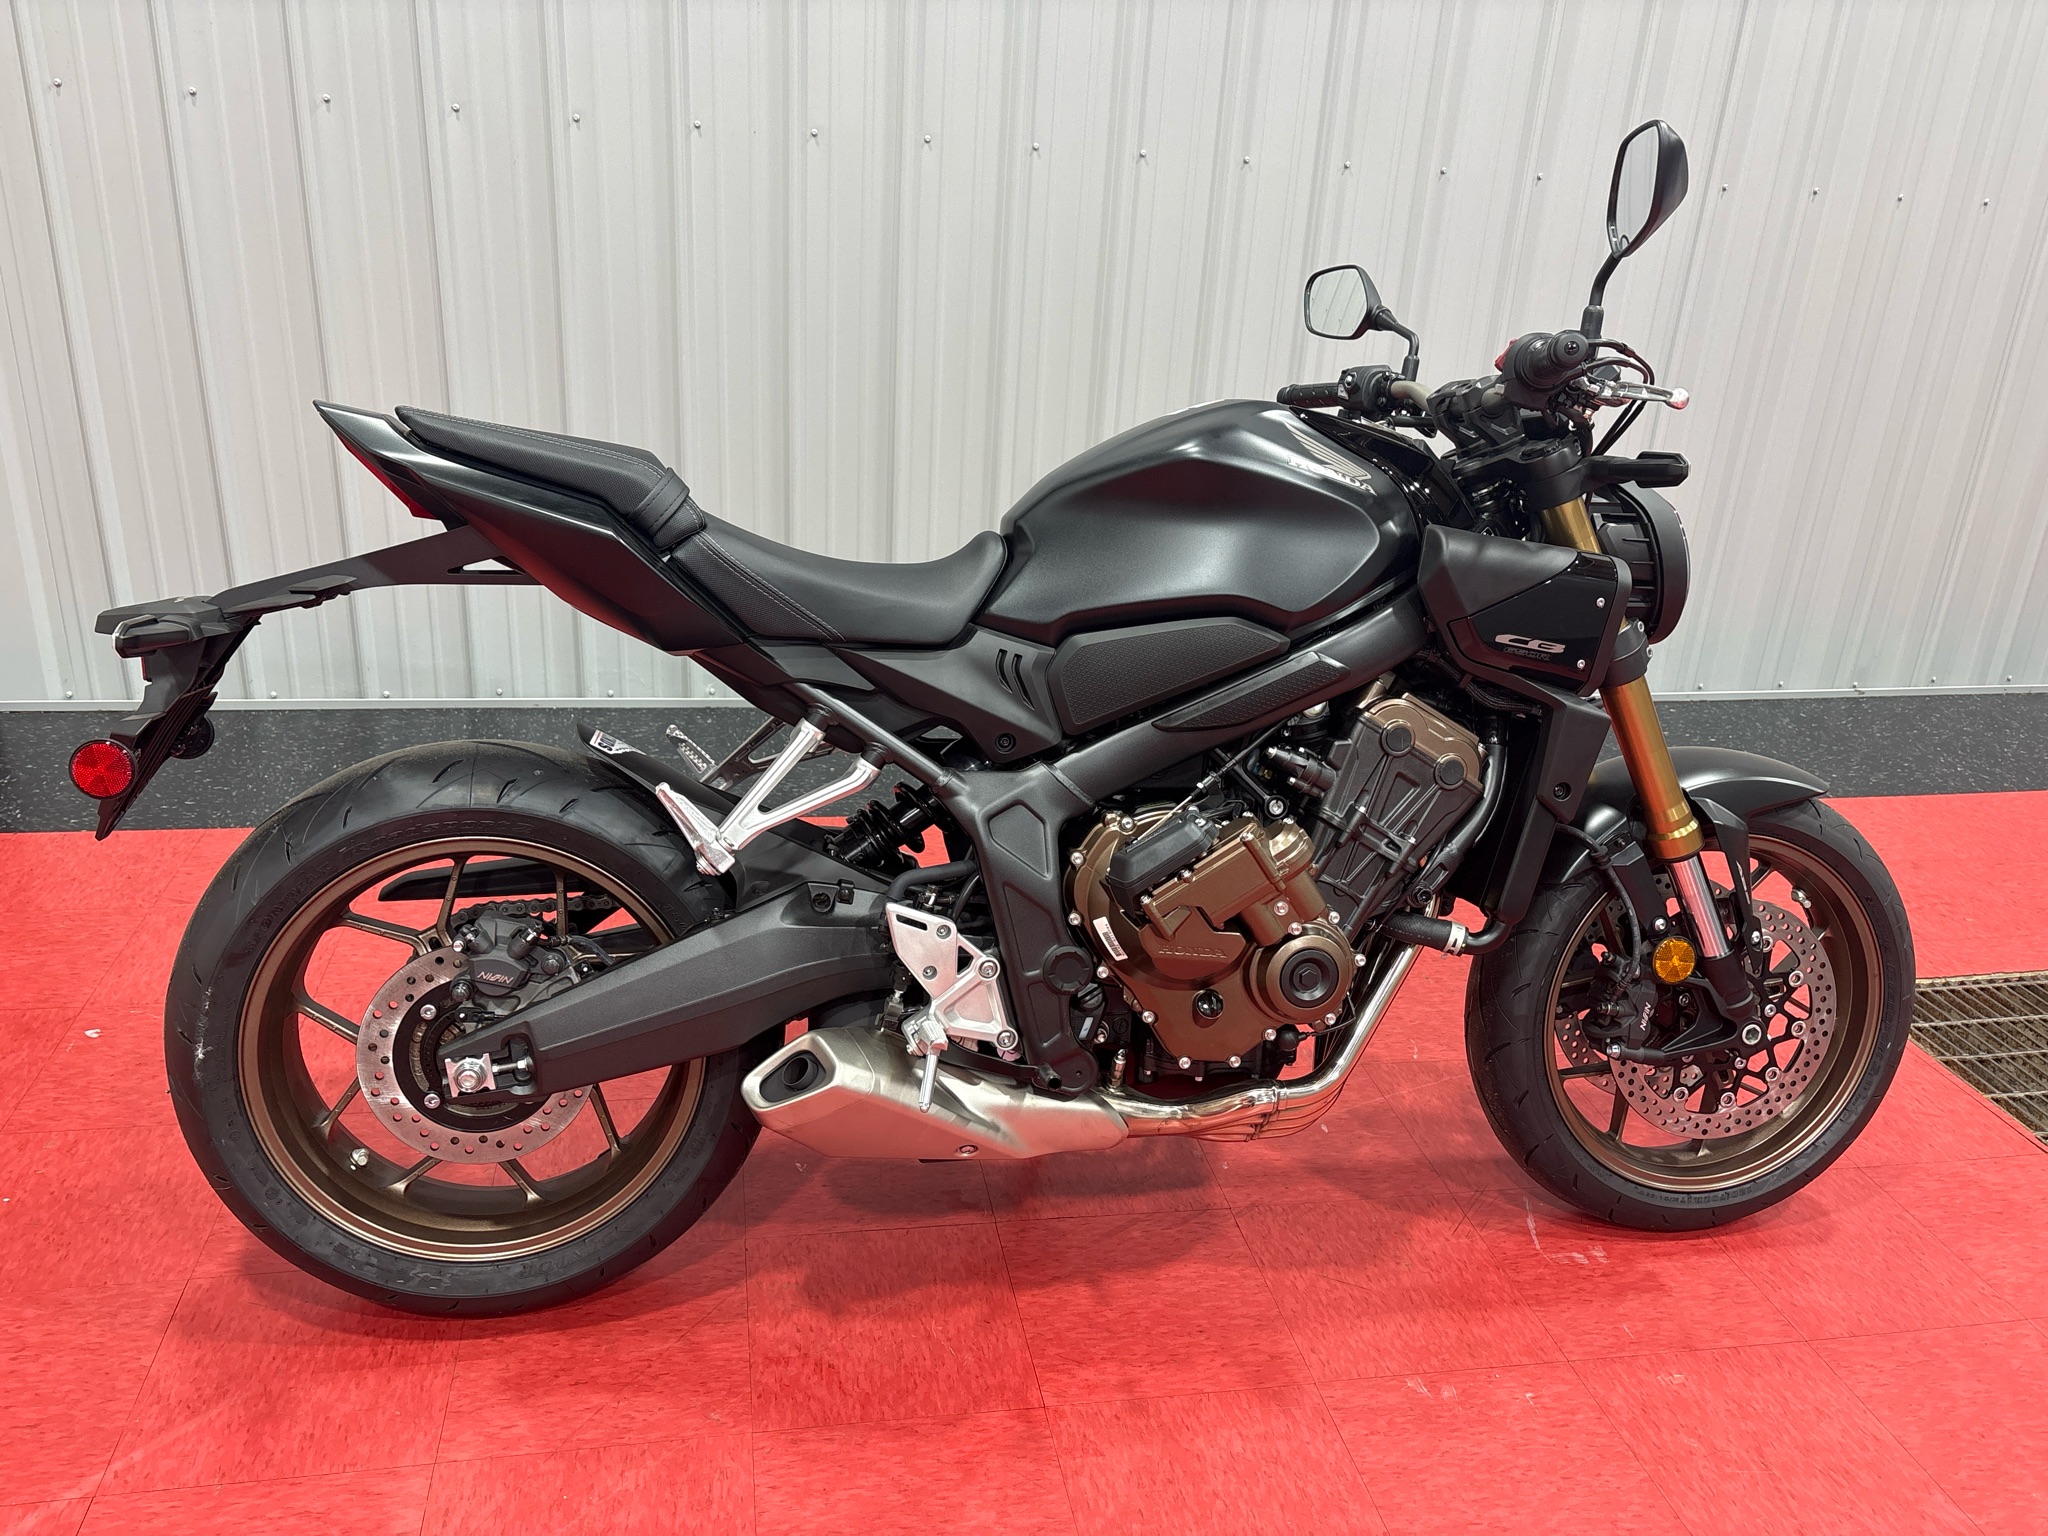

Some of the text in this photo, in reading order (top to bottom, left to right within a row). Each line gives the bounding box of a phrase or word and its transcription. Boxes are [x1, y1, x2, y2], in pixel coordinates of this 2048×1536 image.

[1286, 454, 1378, 496] HONDA
[1494, 633, 1567, 654] CB
[1158, 944, 1228, 959] HONDA
[476, 970, 515, 985] NISSIN
[1639, 1001, 1652, 1032] NISSIN
